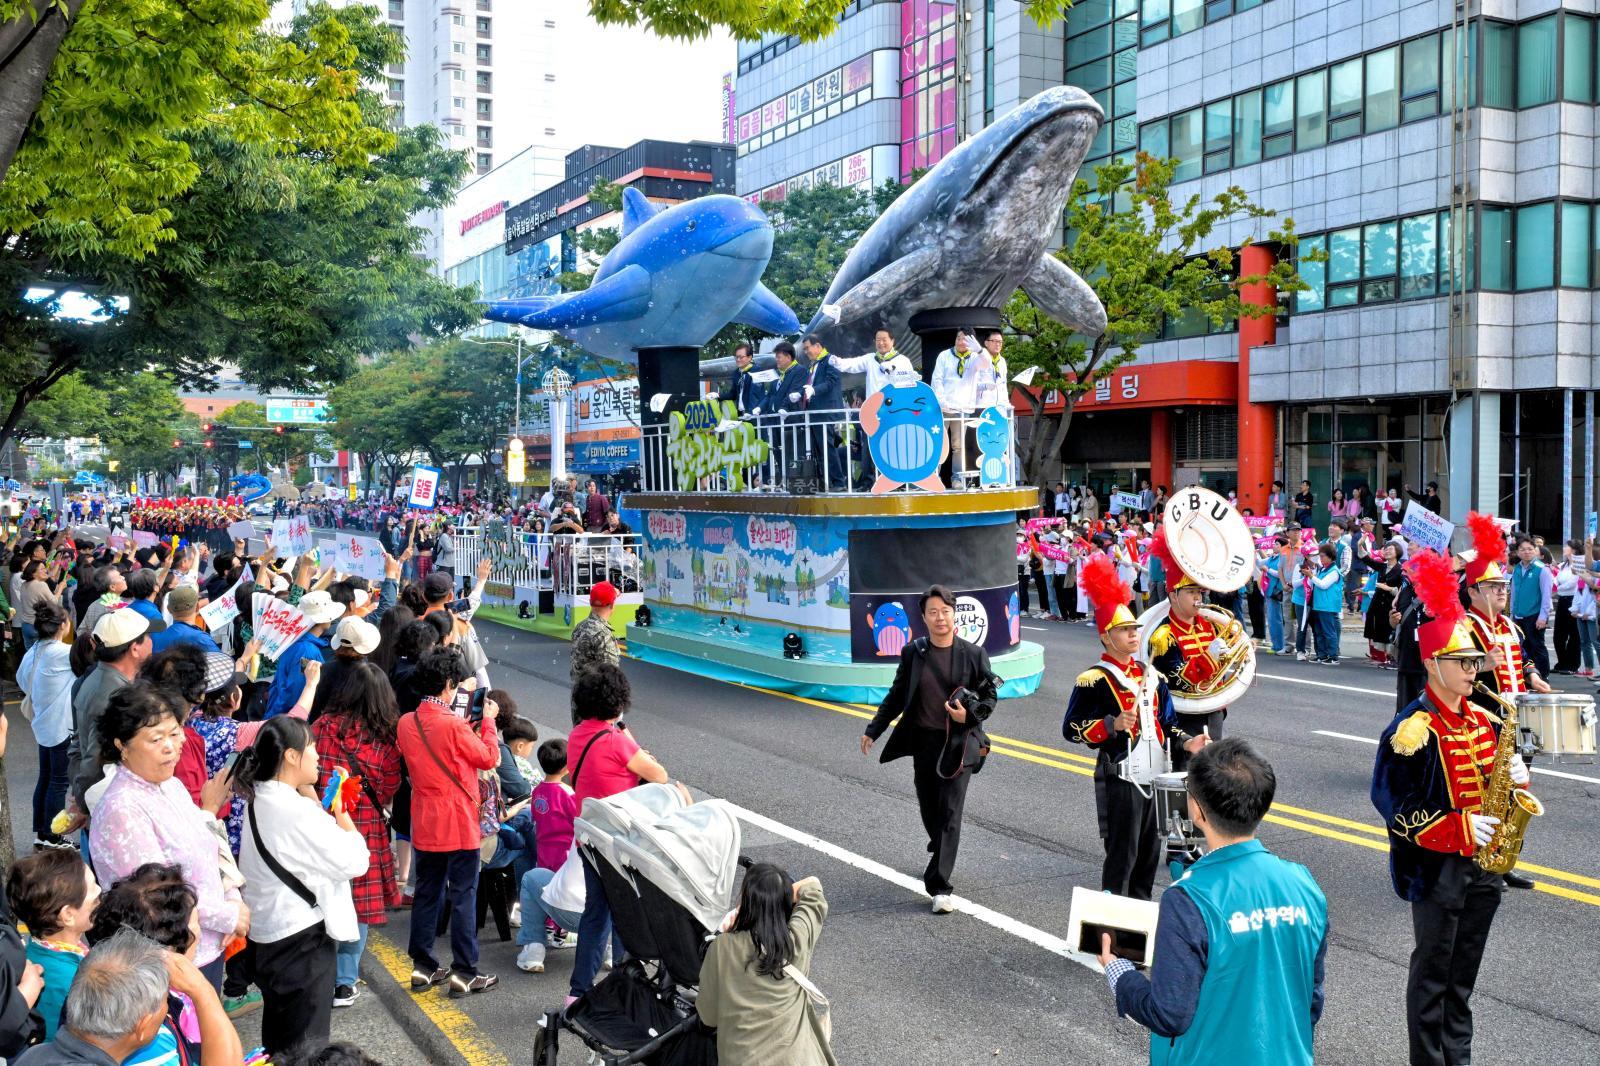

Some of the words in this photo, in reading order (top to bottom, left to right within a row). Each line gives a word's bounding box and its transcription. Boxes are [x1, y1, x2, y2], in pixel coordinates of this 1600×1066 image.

[848, 166, 866, 183] 2379
[685, 403, 717, 429] 2024
[590, 446, 606, 458] EDIYA
[606, 445, 628, 457] COFFEE
[750, 520, 772, 544] 울산의
[774, 525, 795, 549] 희망!
[1228, 906, 1309, 933] 울산광역시
